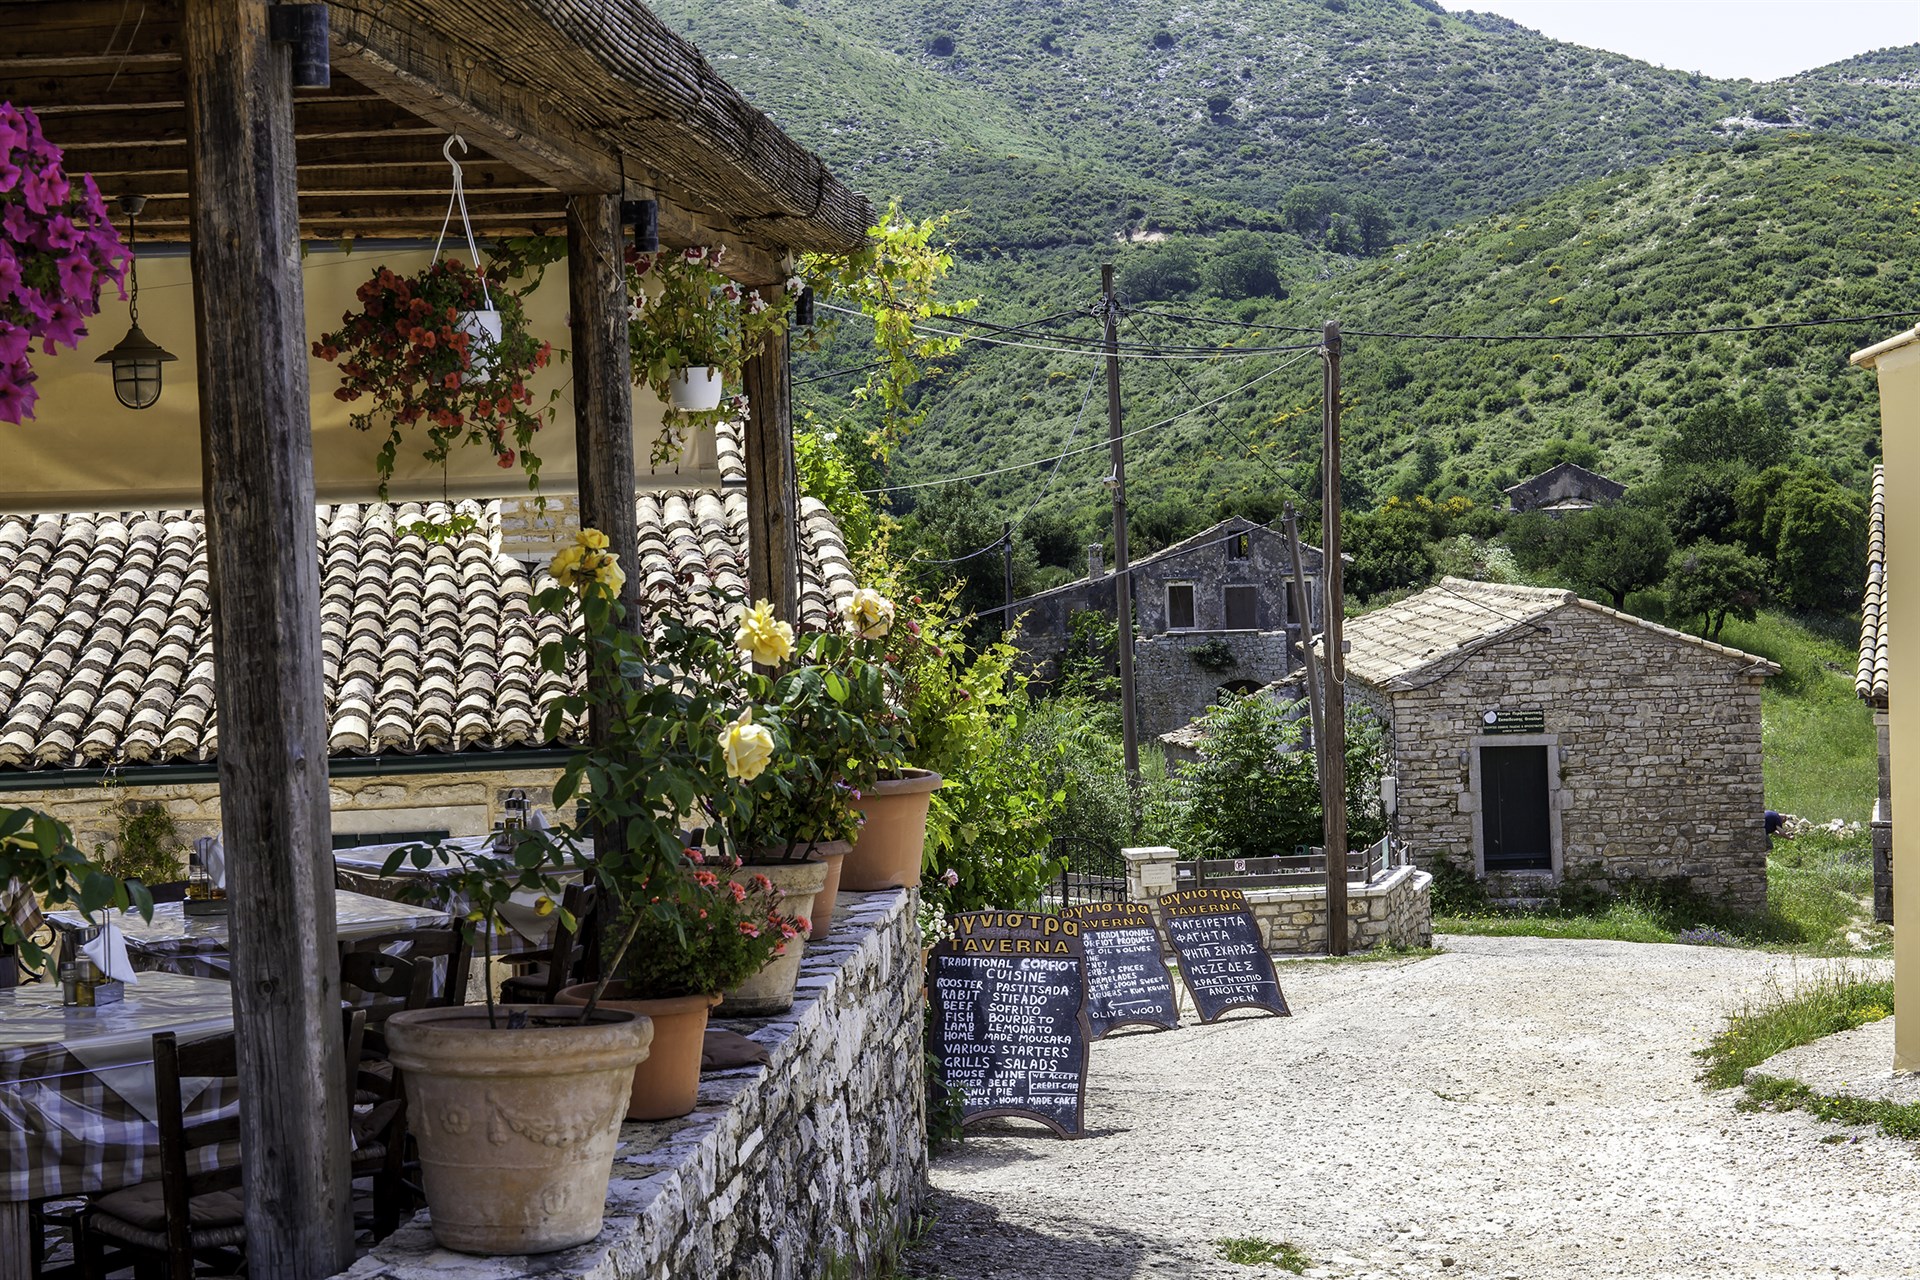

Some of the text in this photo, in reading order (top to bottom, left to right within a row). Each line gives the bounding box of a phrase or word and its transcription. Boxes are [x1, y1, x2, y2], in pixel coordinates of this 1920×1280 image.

[1169, 902, 1241, 916] TAVERNA
[1081, 917, 1146, 928] AVERNA
[1171, 916, 1246, 931] ΜΑΓΕΙΡΕΥΤΑ
[1095, 929, 1152, 940] TRADITIONAL
[1176, 930, 1231, 943] ΦΑΓΗΤΑ
[949, 938, 1069, 954] TAVERNA
[1083, 935, 1155, 948] ORFIOT PRODUCTS
[1122, 945, 1153, 953] OLIVES
[1182, 943, 1258, 961] ΨΗΤΑ ΣΧΑΡΑΣ
[939, 956, 1078, 972] TRADITIONAL CORFIOT
[1117, 964, 1145, 973] SPICES
[1191, 961, 1254, 975] ΜΕΖΕΔΕΣ
[986, 968, 1047, 983] CUISINE
[1227, 974, 1262, 984] ΝΤΟΠΙΟ
[936, 978, 1069, 996] ROOSTER PASTITSADA
[1113, 980, 1137, 989] SPOON
[1139, 976, 1164, 985] SWEET
[1209, 984, 1259, 996] ΑΝΟΙΚΤΑ
[941, 990, 1048, 1006] RABIT STIFADO
[1224, 994, 1255, 1004] OPEN
[943, 1001, 1041, 1016] BEEF SOFRITO
[1092, 1005, 1163, 1019] OLIVE WOOD
[945, 1012, 1055, 1025] FISH BOURDETO
[944, 1022, 1053, 1034] LAMB LEMONATO
[944, 1031, 1072, 1045] HOME MADE MOUSAKA
[944, 1043, 1069, 1059] VARIOUS STARTERS
[944, 1056, 990, 1069] GRILLS
[947, 1069, 1026, 1079] HOUSE WINE
[988, 1079, 1017, 1088] BEER
[946, 1087, 1013, 1096] LNUT PIE
[999, 1096, 1025, 1105] HOME
[1026, 1096, 1053, 1106] MADE
[1053, 1096, 1078, 1105] CAKE
